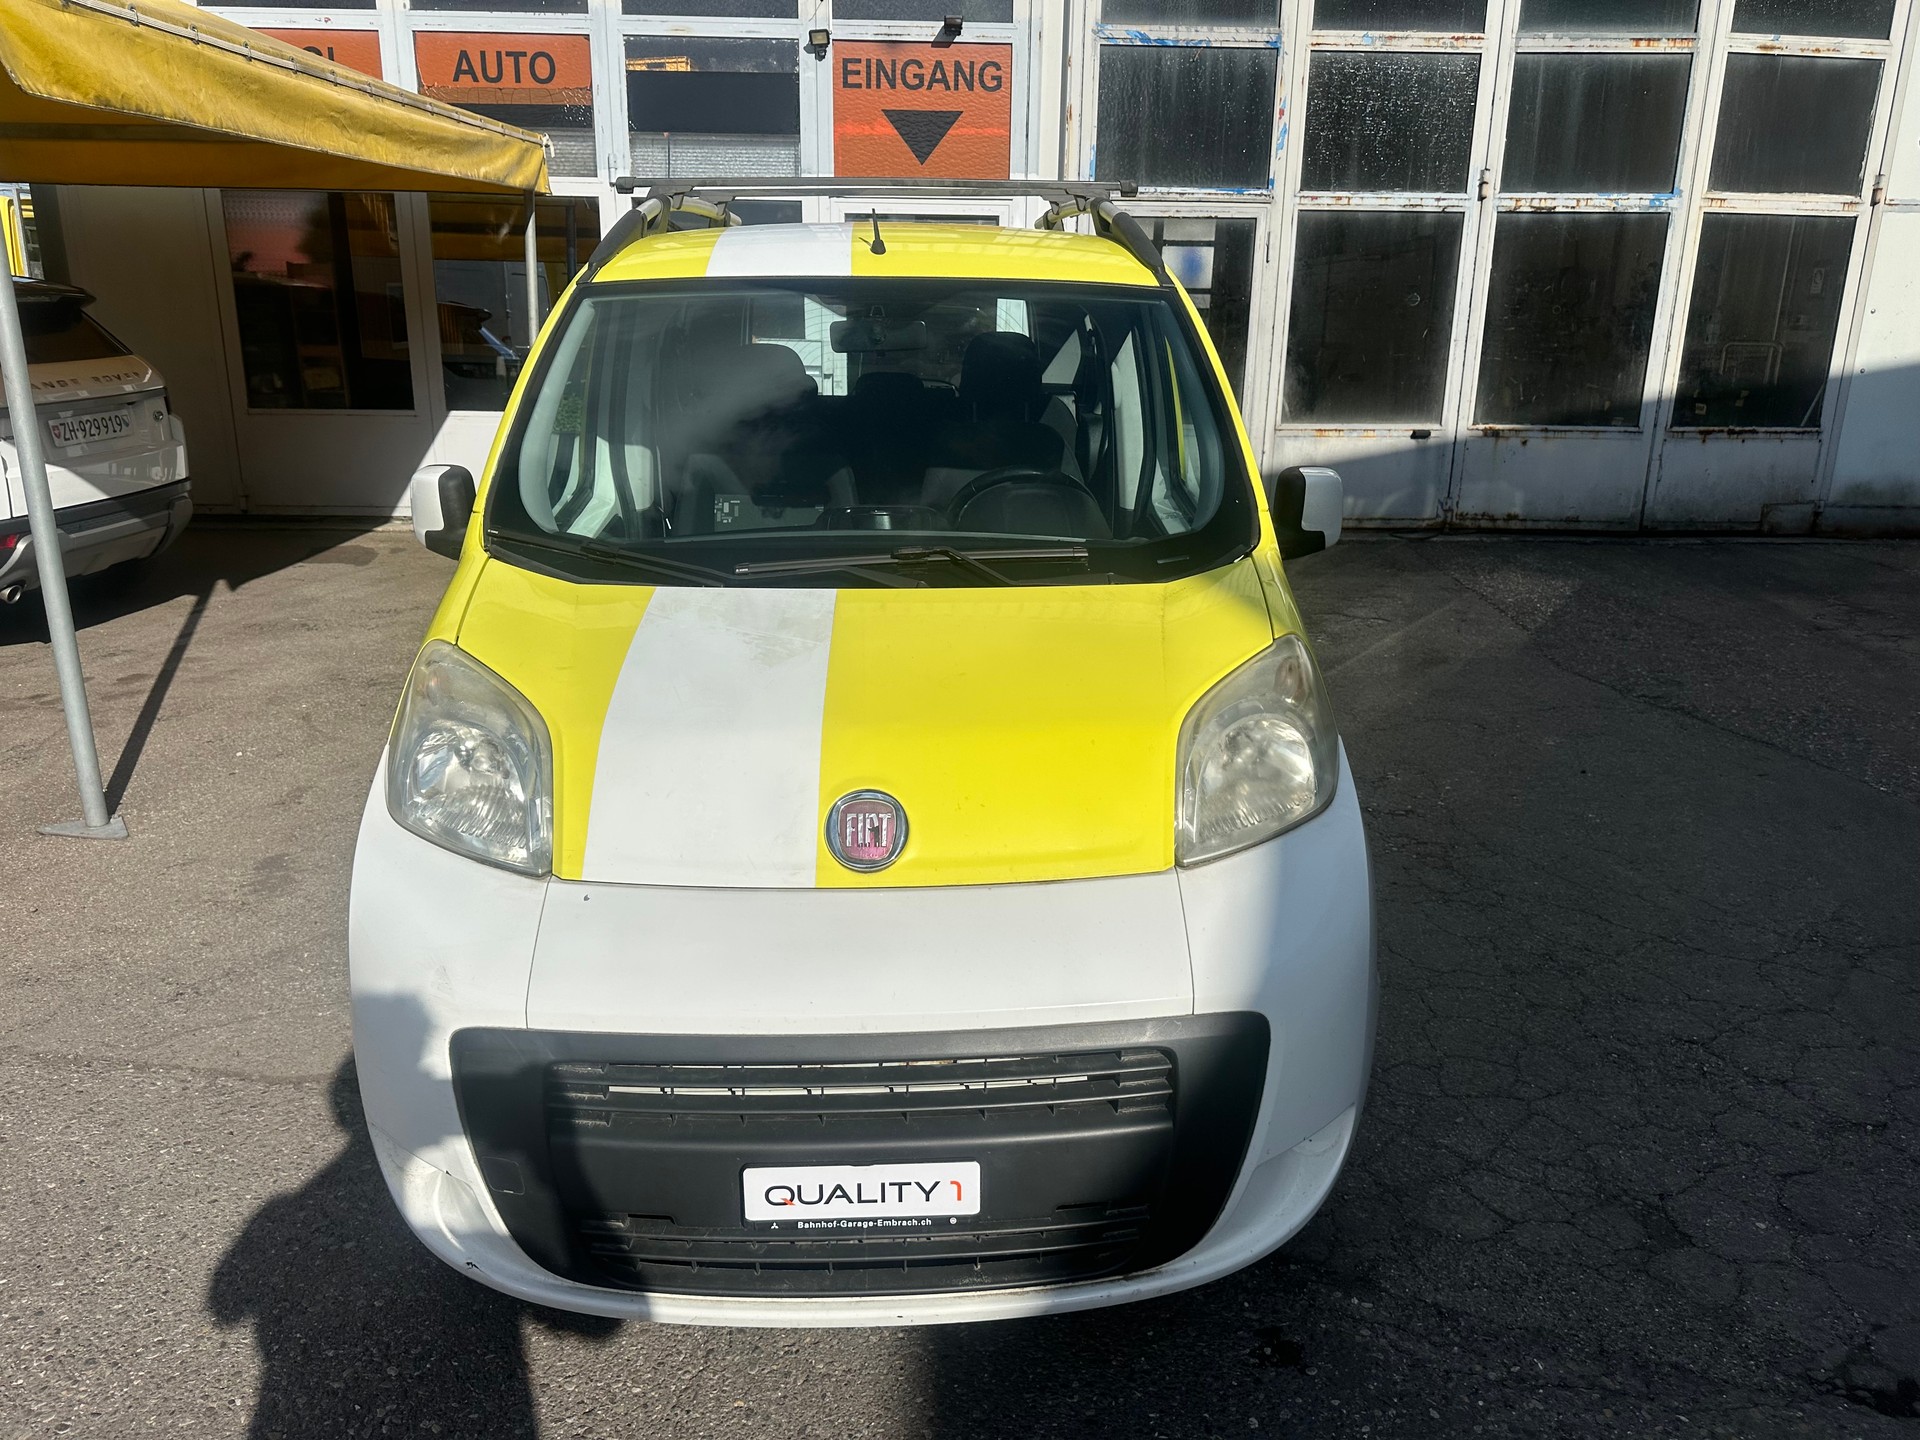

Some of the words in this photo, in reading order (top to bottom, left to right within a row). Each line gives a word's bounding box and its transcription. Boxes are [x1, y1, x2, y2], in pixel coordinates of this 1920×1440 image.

[452, 50, 556, 84] AUTO
[842, 58, 1003, 92] EINGANG
[31, 378, 80, 391] ANGE
[91, 371, 140, 384] ROVER
[846, 813, 892, 848] FIAT
[764, 1180, 941, 1206] QUALITY
[797, 1217, 932, 1229] Bahnhof-Garage-Embrach.ch
